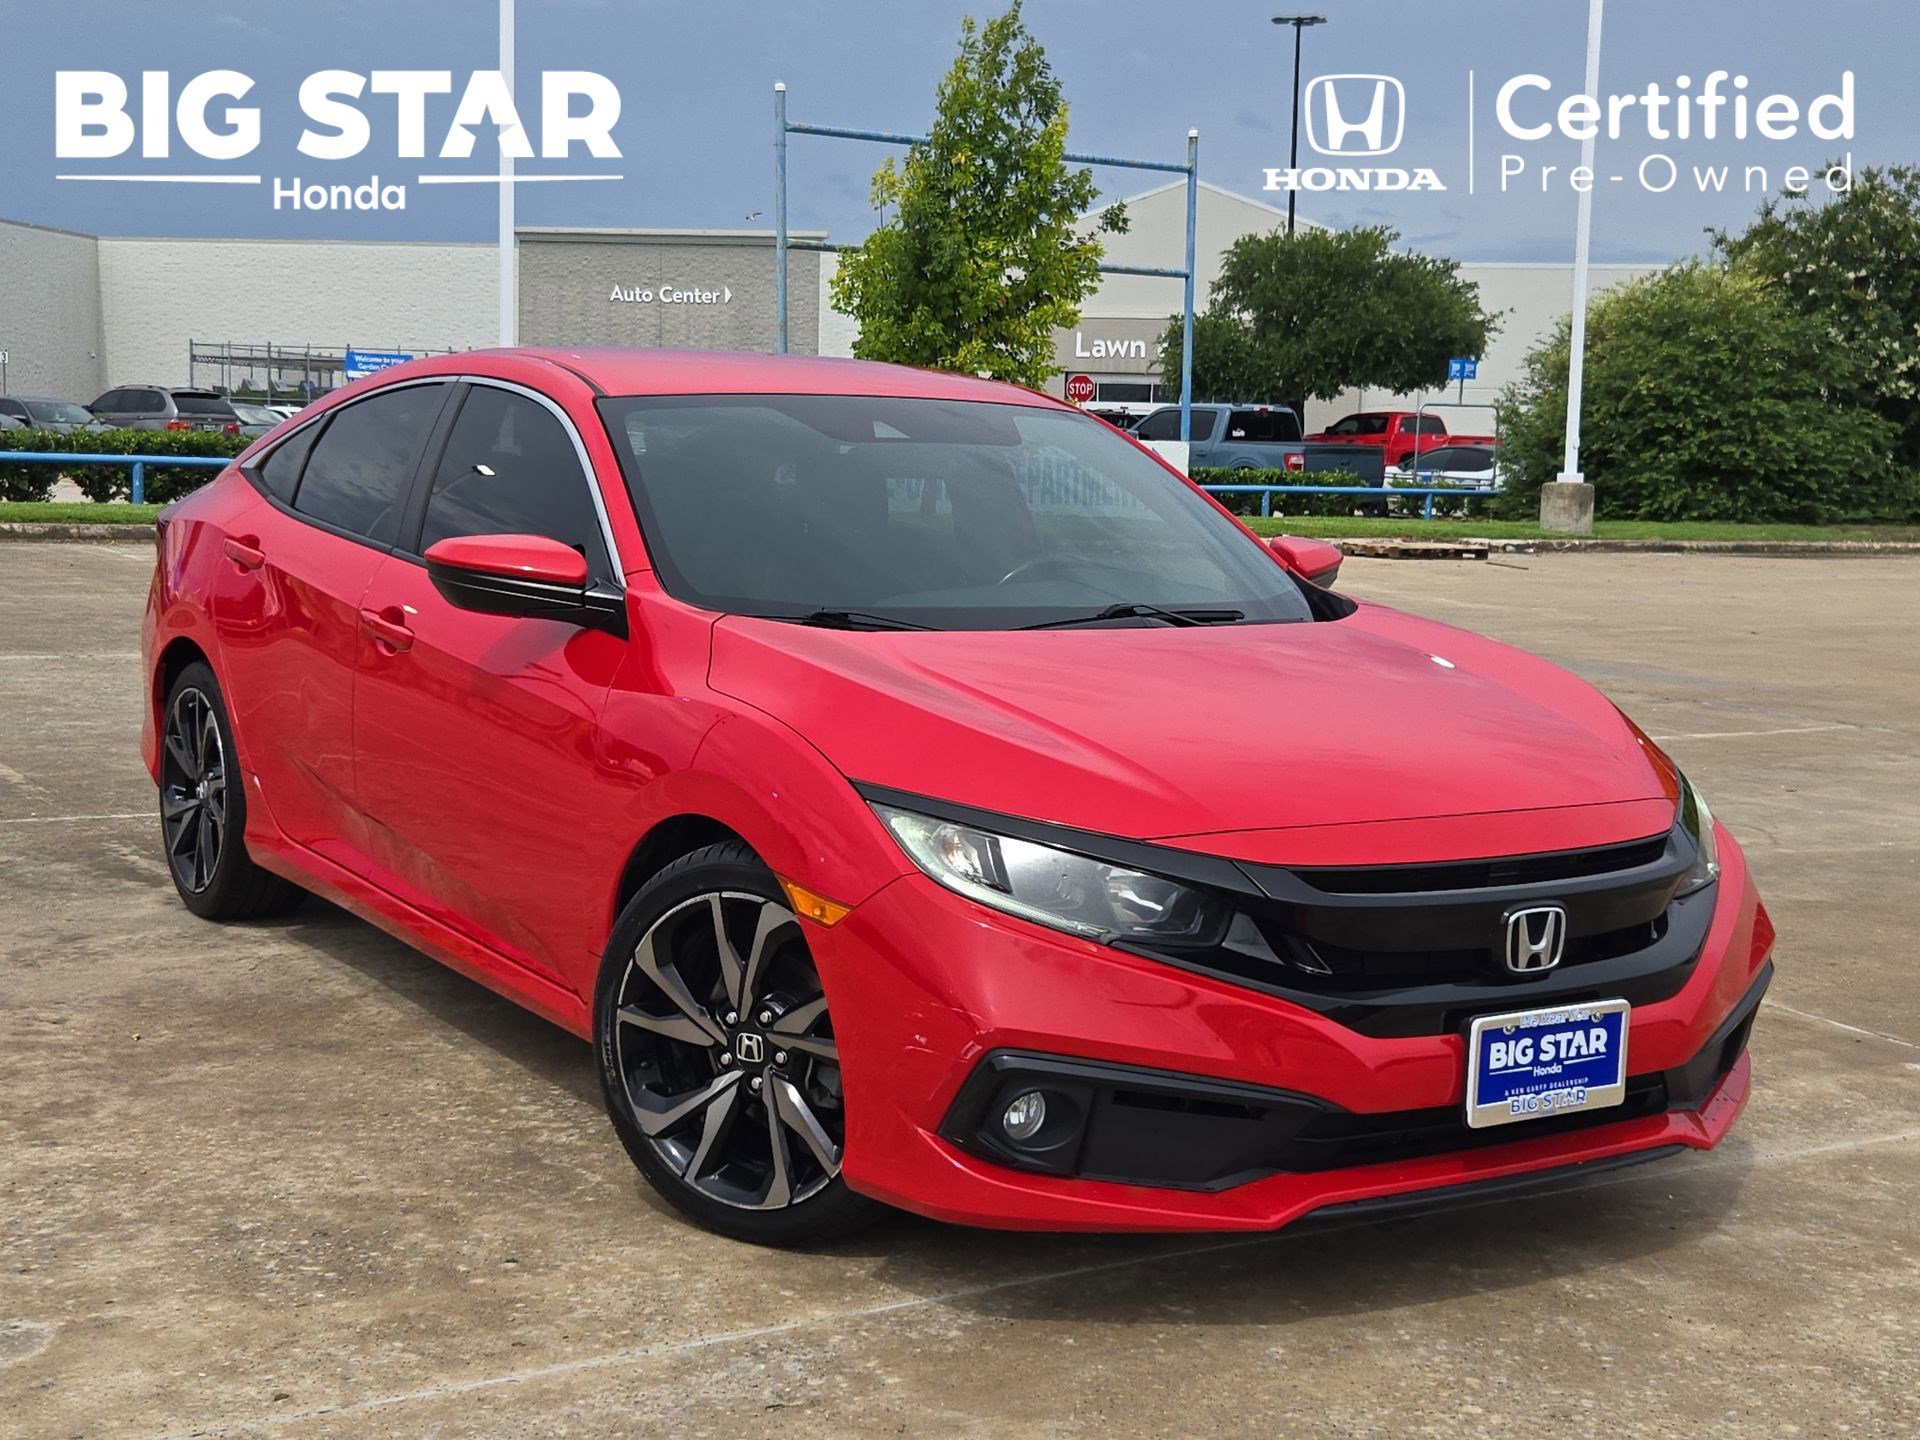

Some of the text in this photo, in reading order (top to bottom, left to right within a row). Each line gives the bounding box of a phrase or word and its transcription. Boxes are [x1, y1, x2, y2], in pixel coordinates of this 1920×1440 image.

[609, 284, 720, 304] Auto Center
[1075, 332, 1146, 358] Lawn
[355, 355, 382, 363] Welcome
[1069, 383, 1092, 395] STOP
[1489, 1027, 1608, 1069] BIG STAR
[1532, 1063, 1563, 1077] Honda
[1510, 1096, 1537, 1113] BIG
[1543, 1089, 1587, 1109] STAR
